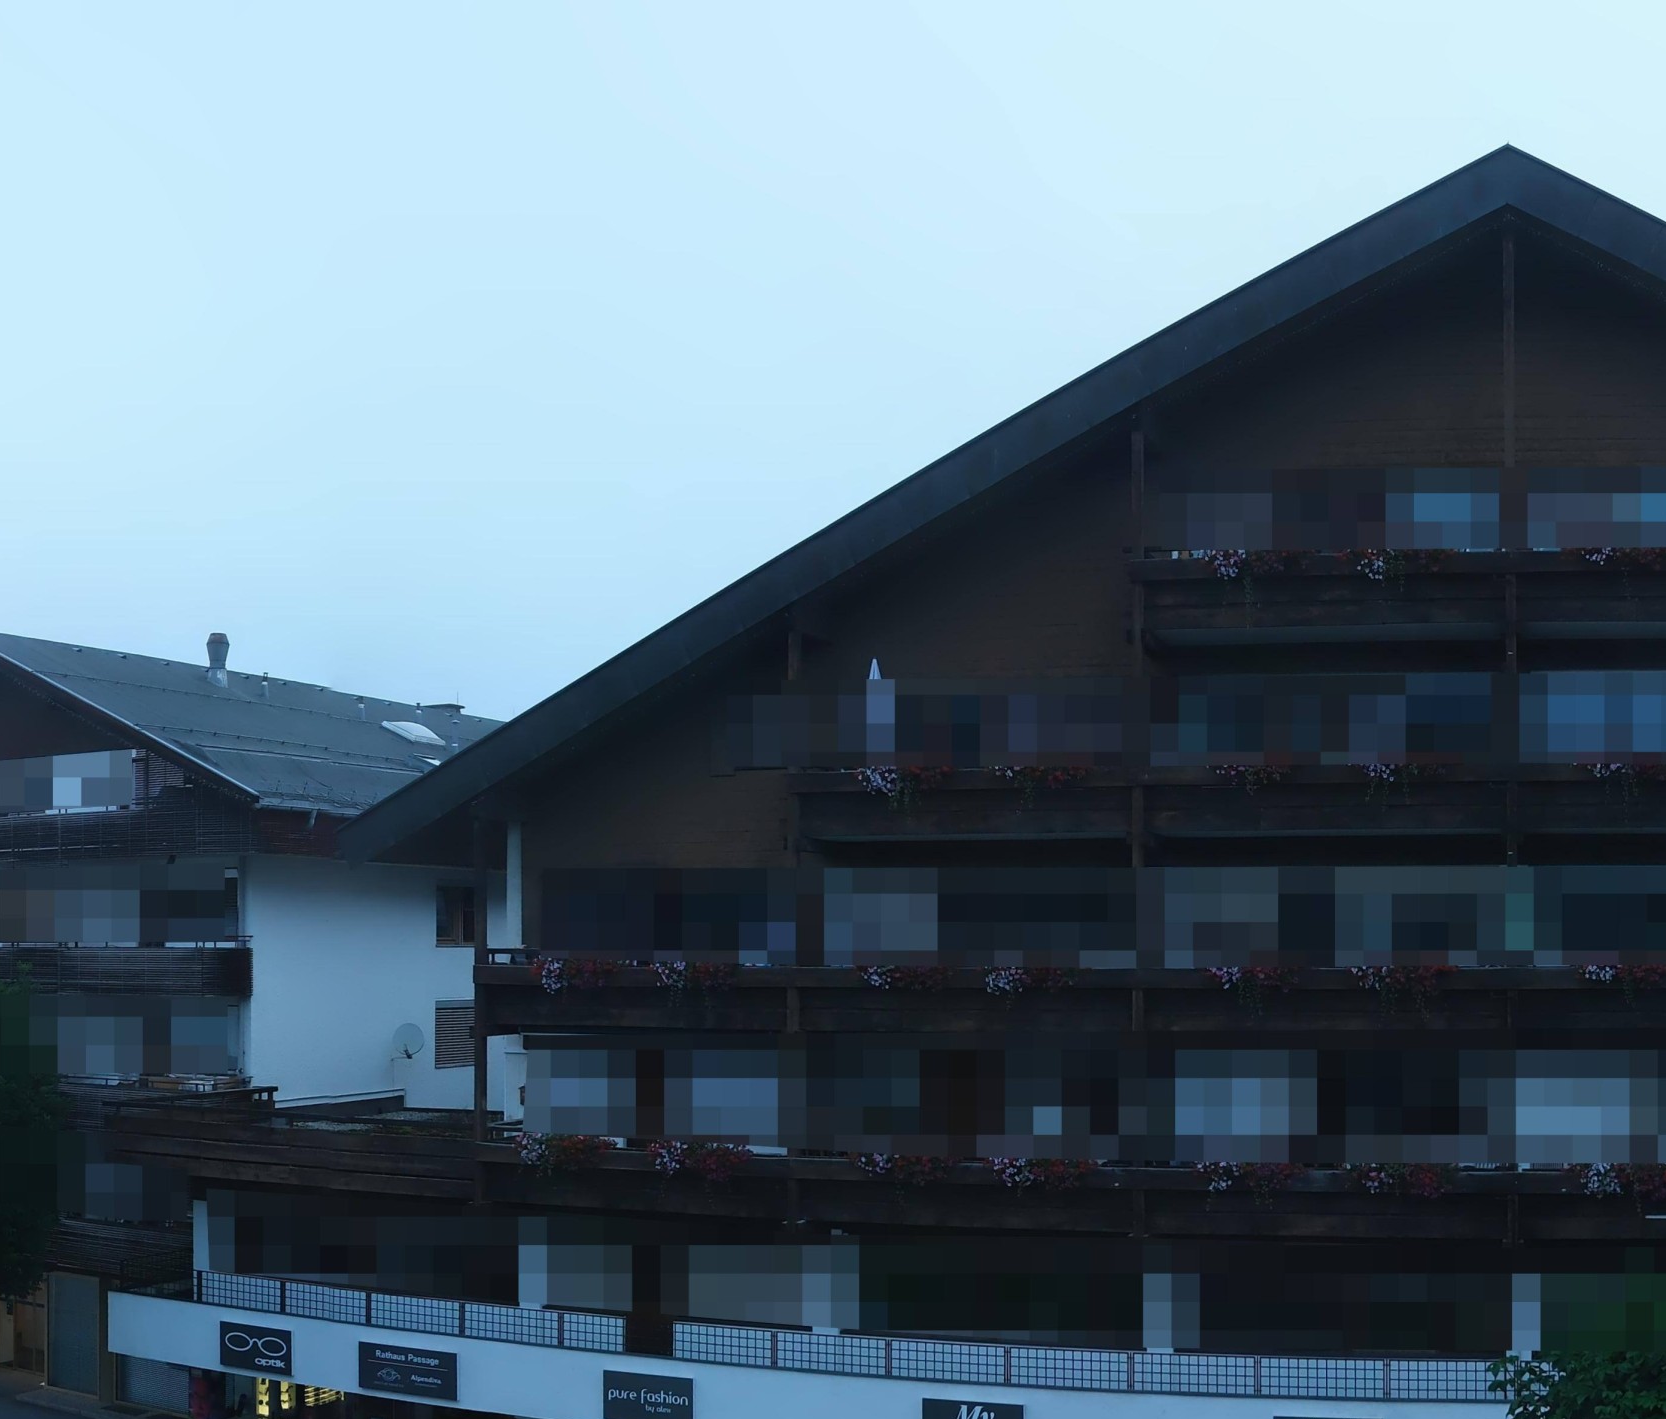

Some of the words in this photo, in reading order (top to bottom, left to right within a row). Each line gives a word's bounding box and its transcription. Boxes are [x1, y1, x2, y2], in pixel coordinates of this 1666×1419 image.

[254, 1357, 286, 1369] optik
[375, 1349, 406, 1362] Rathaus
[408, 1353, 439, 1366] Passage
[608, 1388, 637, 1401] pure
[640, 1388, 689, 1406] fashion
